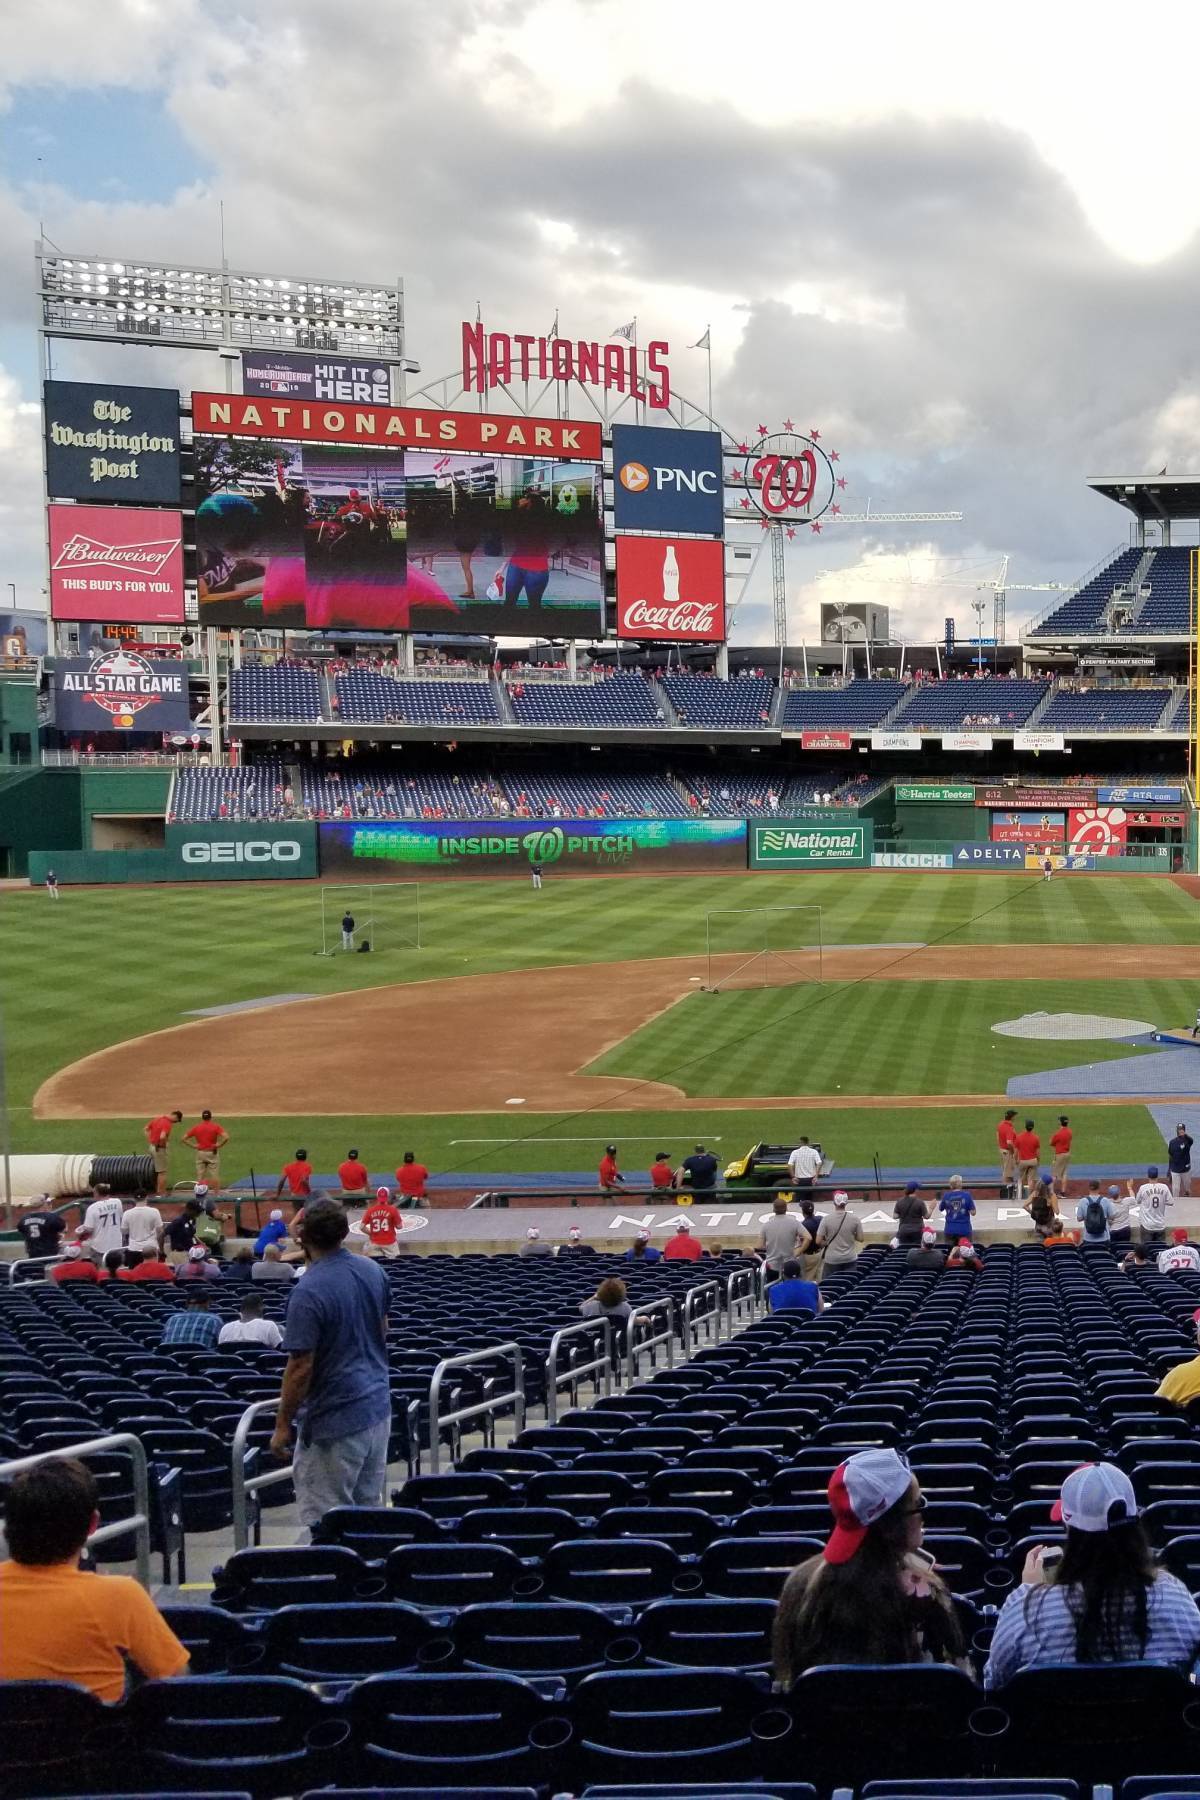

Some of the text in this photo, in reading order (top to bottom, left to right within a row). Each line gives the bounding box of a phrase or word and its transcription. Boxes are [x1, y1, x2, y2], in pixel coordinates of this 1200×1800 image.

[315, 364, 368, 381] HIT IT
[462, 321, 669, 408] NATIONALS
[246, 368, 270, 380] HOME
[270, 370, 288, 382] RUN
[316, 380, 389, 403] HERE
[94, 400, 132, 423] The
[210, 402, 581, 449] NATIONALS PARK
[50, 421, 176, 455] Washington
[90, 457, 139, 482] Post
[653, 467, 718, 494] PNC
[62, 543, 167, 562] Budweiser
[62, 579, 174, 593] THIS BUD'S FOR YOU.
[624, 600, 718, 632] Coca-Cola
[63, 674, 182, 693] ALL STAR GAME
[910, 790, 972, 798] Harris Teeter
[182, 840, 300, 863] GEICO
[442, 837, 520, 855] INSIDE
[567, 836, 633, 853] PITCH
[974, 849, 1021, 858] DELTA
[894, 854, 946, 867] KOCH
[1152, 1196, 1160, 1208] 8
[99, 1213, 117, 1227] 71
[372, 1219, 390, 1232] 34
